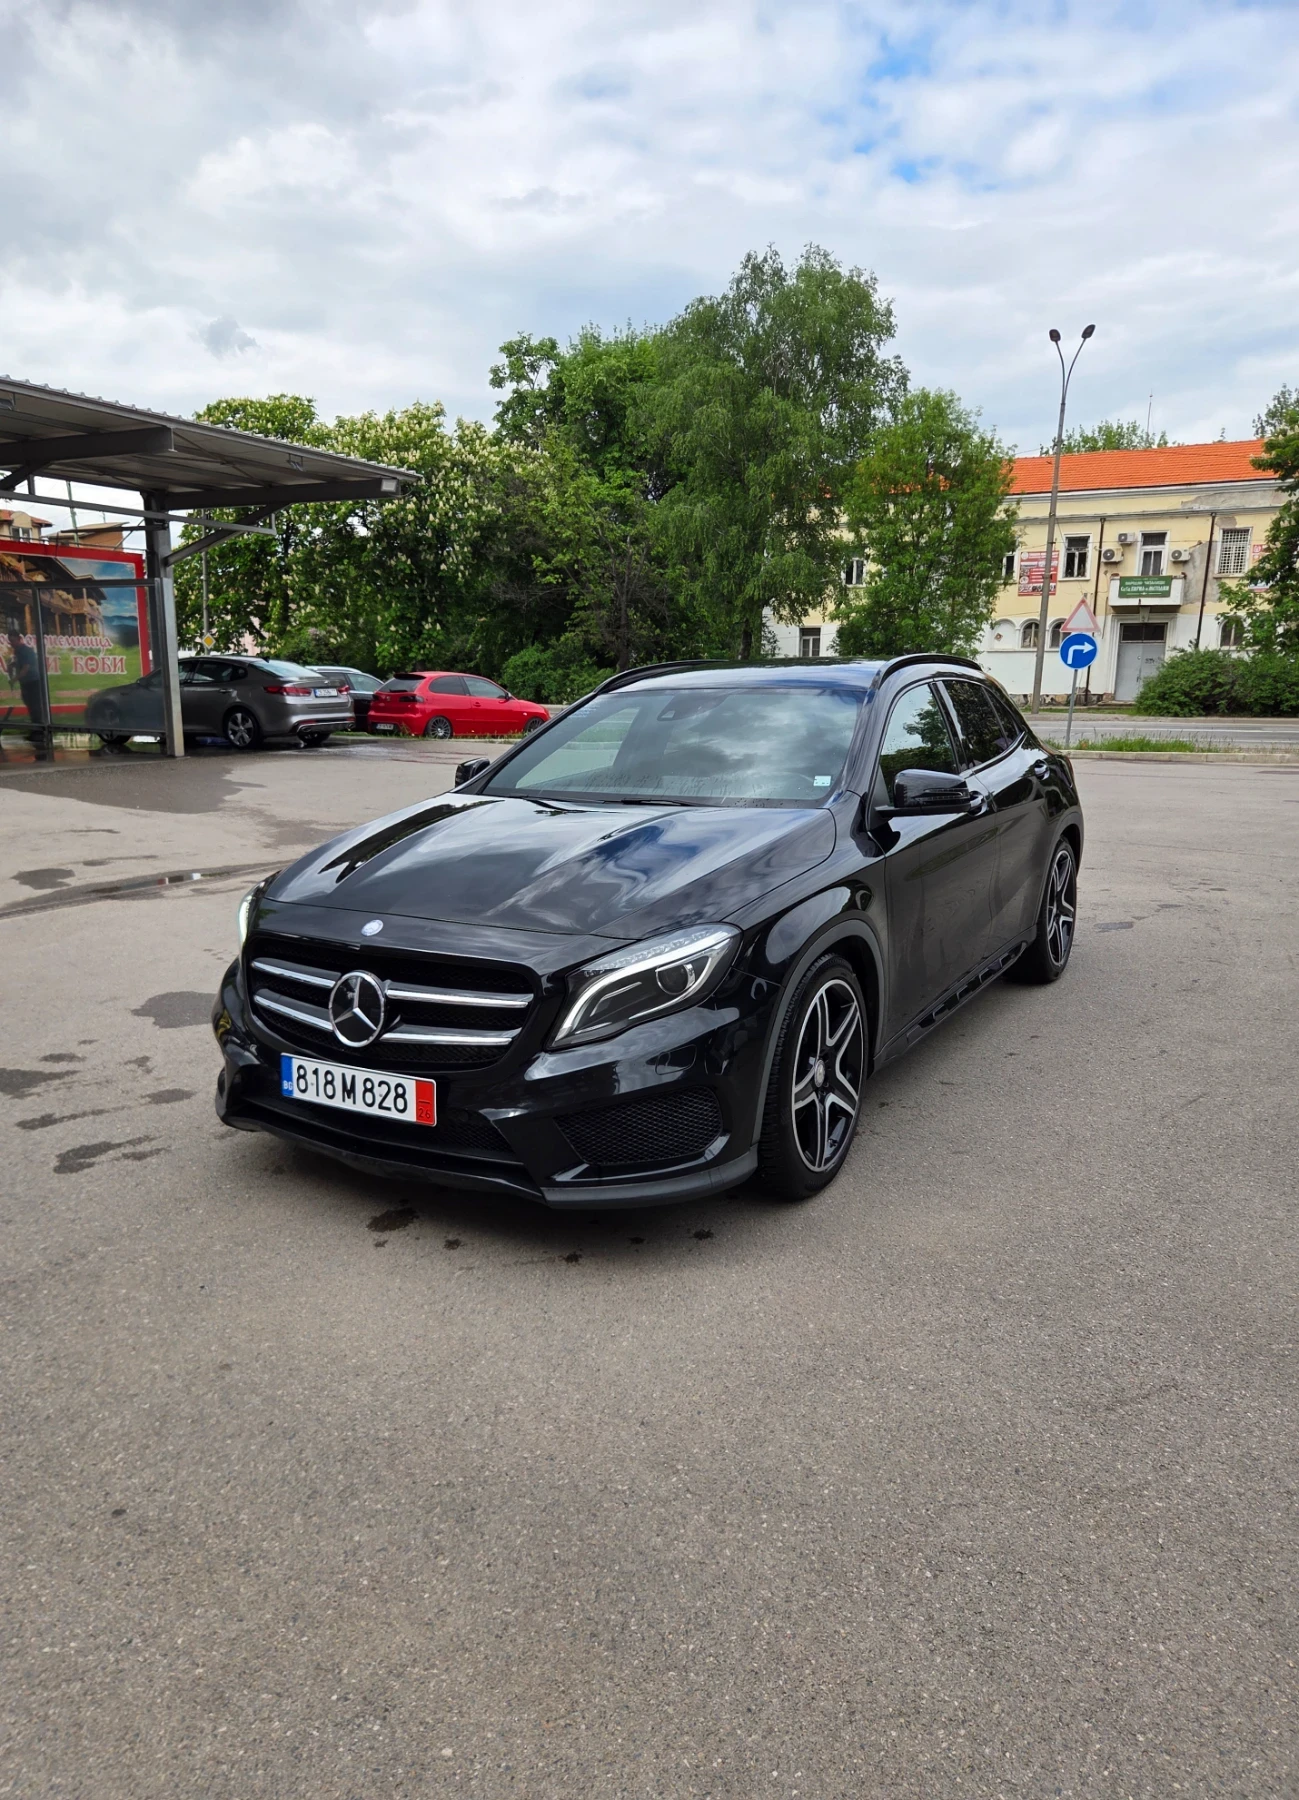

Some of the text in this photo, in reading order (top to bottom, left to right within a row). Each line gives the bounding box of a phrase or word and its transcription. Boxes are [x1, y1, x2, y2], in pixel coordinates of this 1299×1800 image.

[72, 655, 127, 675] БОБИ
[283, 1064, 431, 1119] BG 818M828 26
